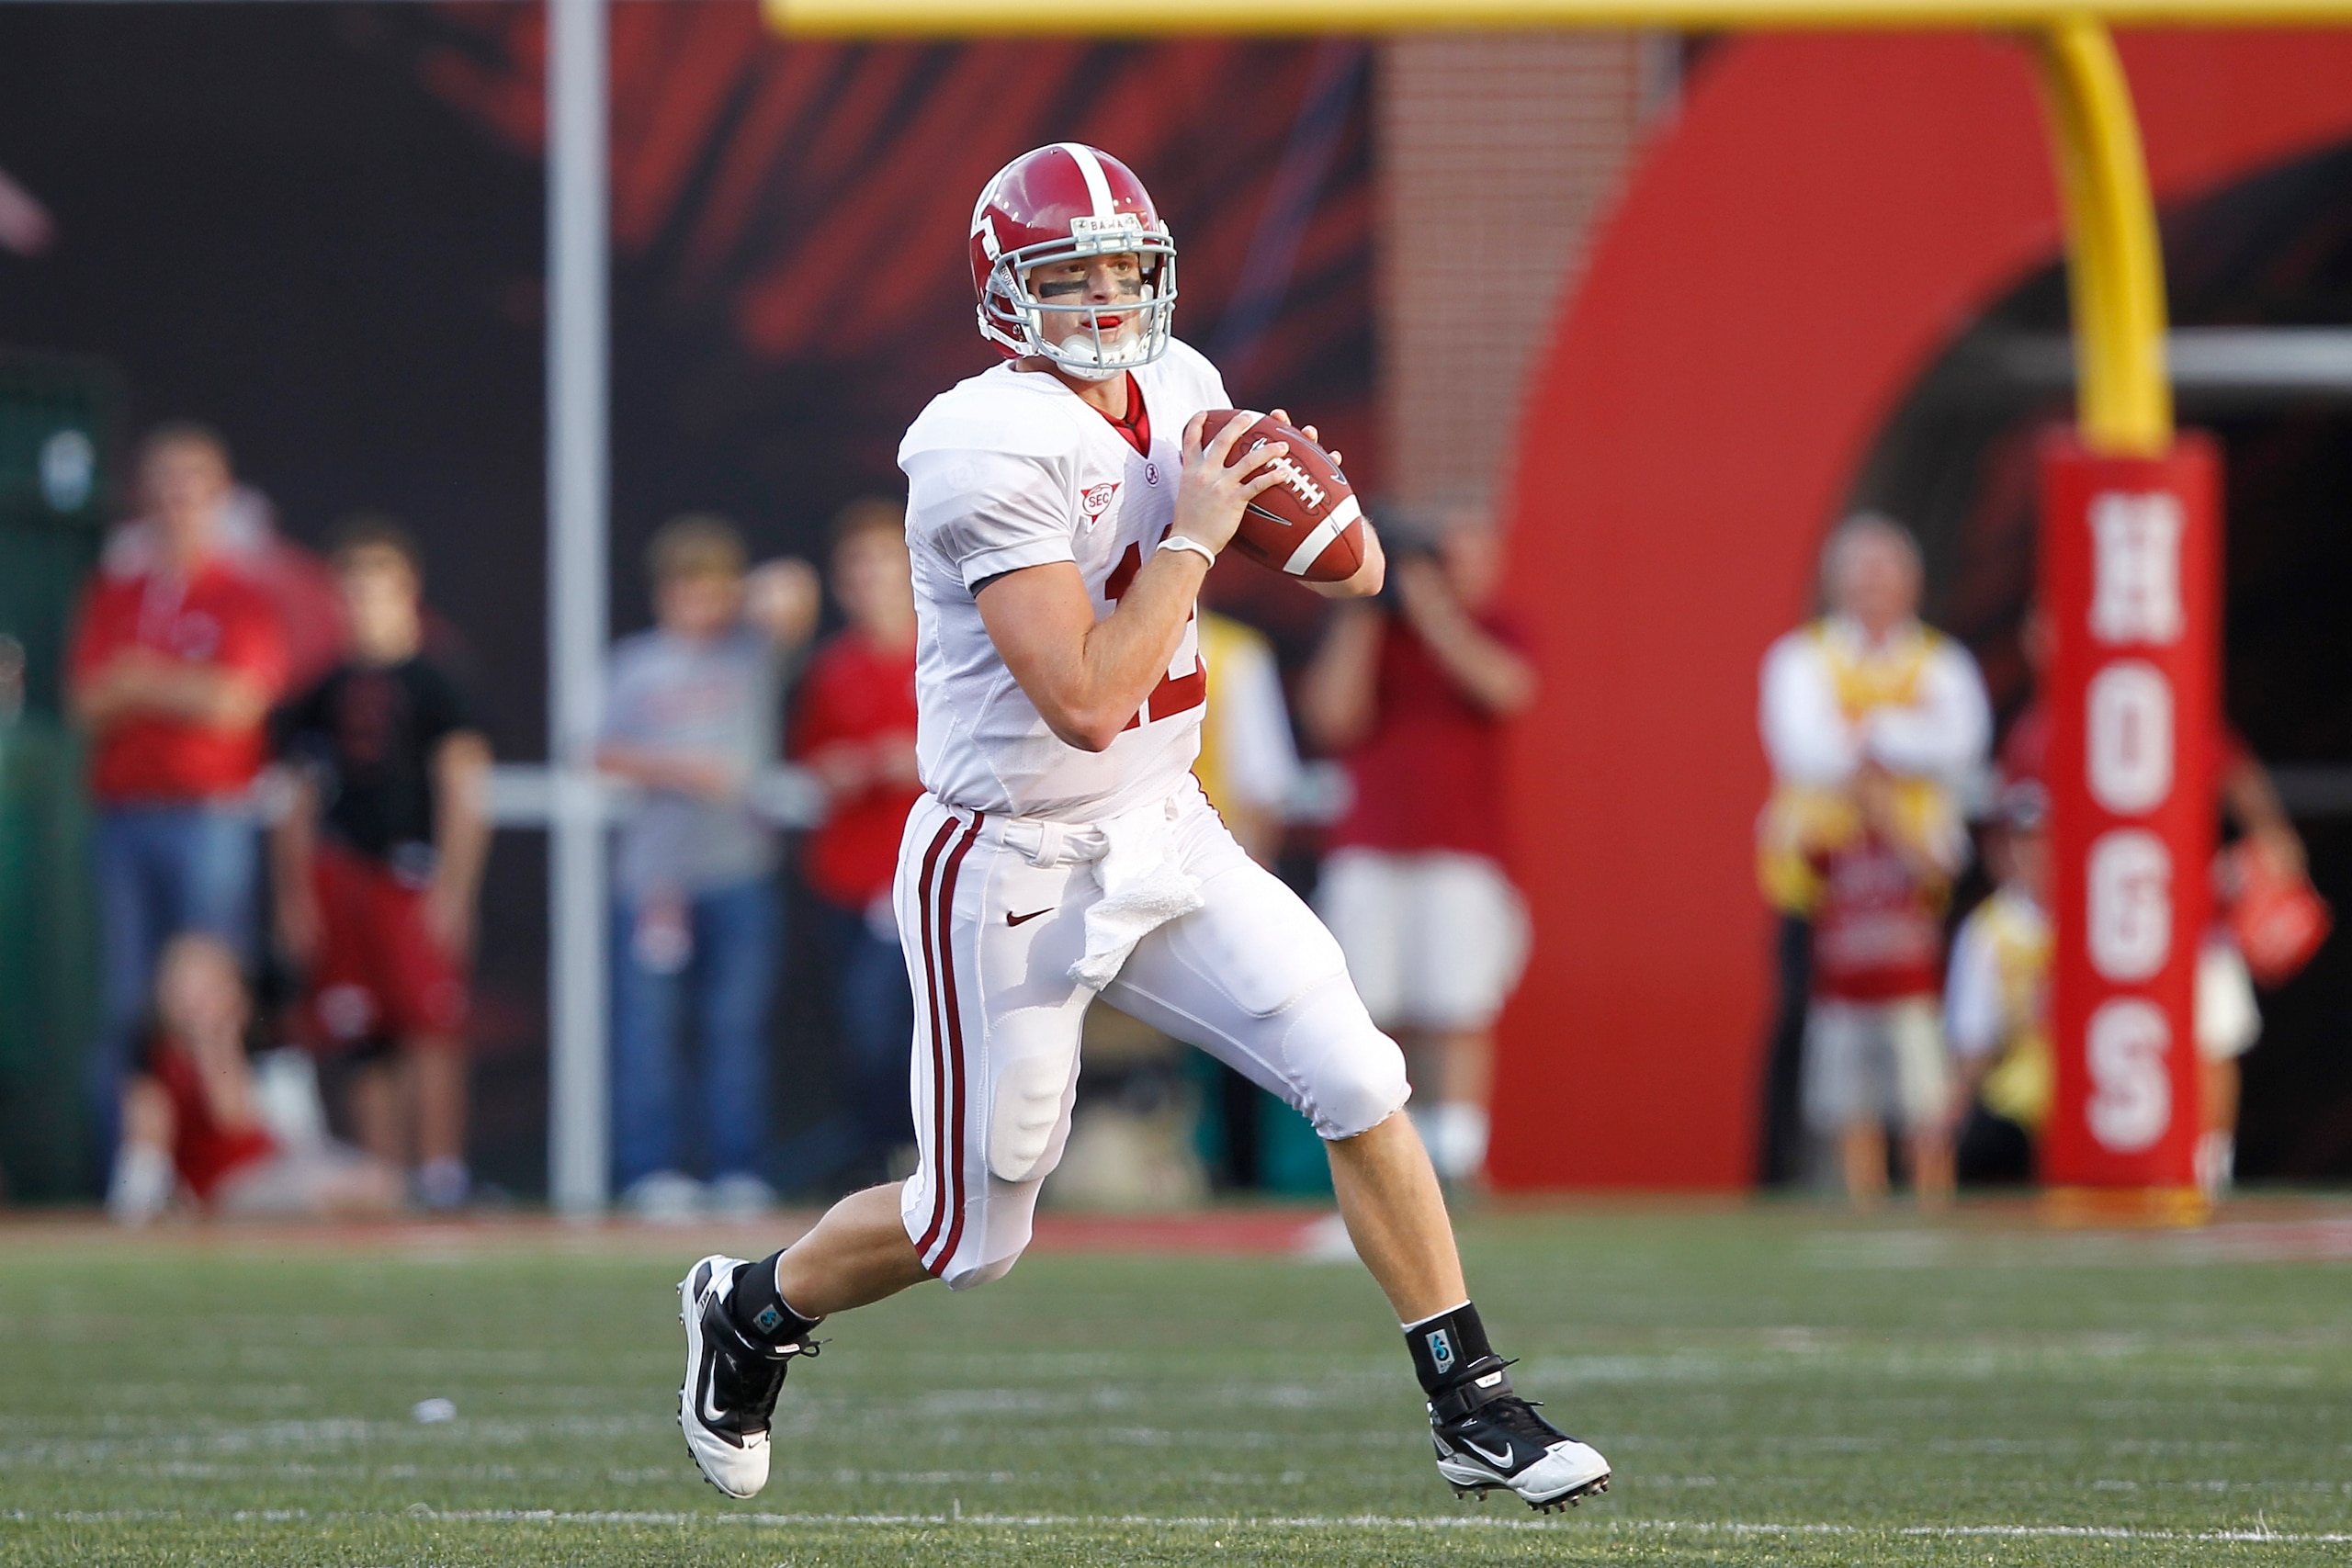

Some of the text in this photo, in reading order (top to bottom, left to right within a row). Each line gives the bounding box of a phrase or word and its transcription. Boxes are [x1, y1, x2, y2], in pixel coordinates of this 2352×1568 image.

[1090, 220, 1124, 231] BAMA
[1088, 491, 1110, 508] SEC
[2087, 491, 2186, 1156] HOGS
